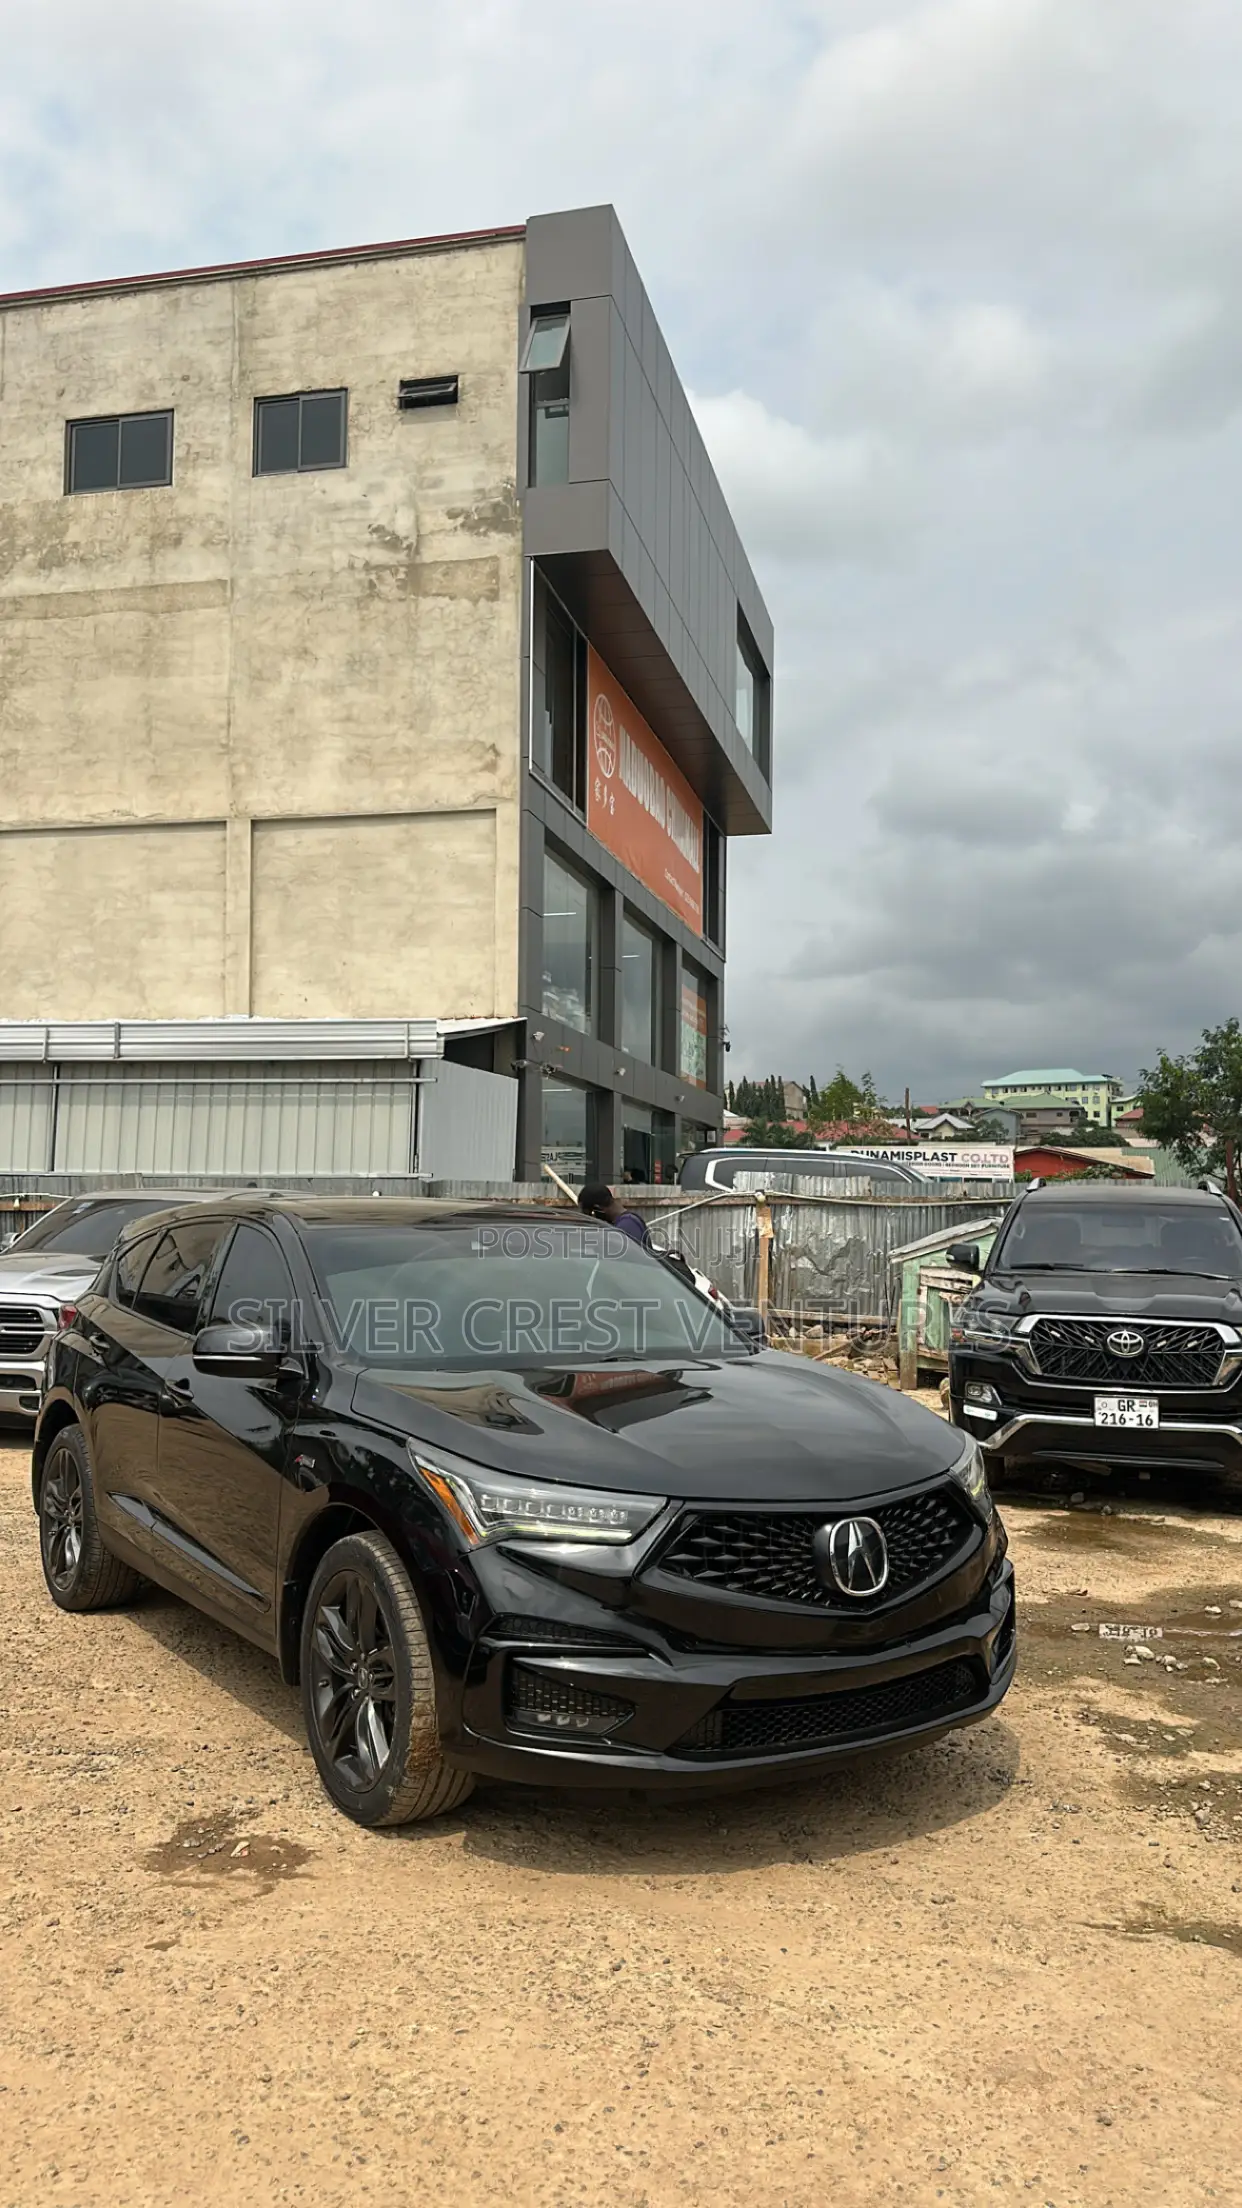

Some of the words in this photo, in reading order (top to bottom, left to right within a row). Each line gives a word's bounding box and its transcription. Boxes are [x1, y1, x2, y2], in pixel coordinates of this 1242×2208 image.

[851, 1150, 958, 1162] NAMISPLAST
[1117, 1399, 1137, 1412] GR
[1101, 1413, 1153, 1426] 216-16
